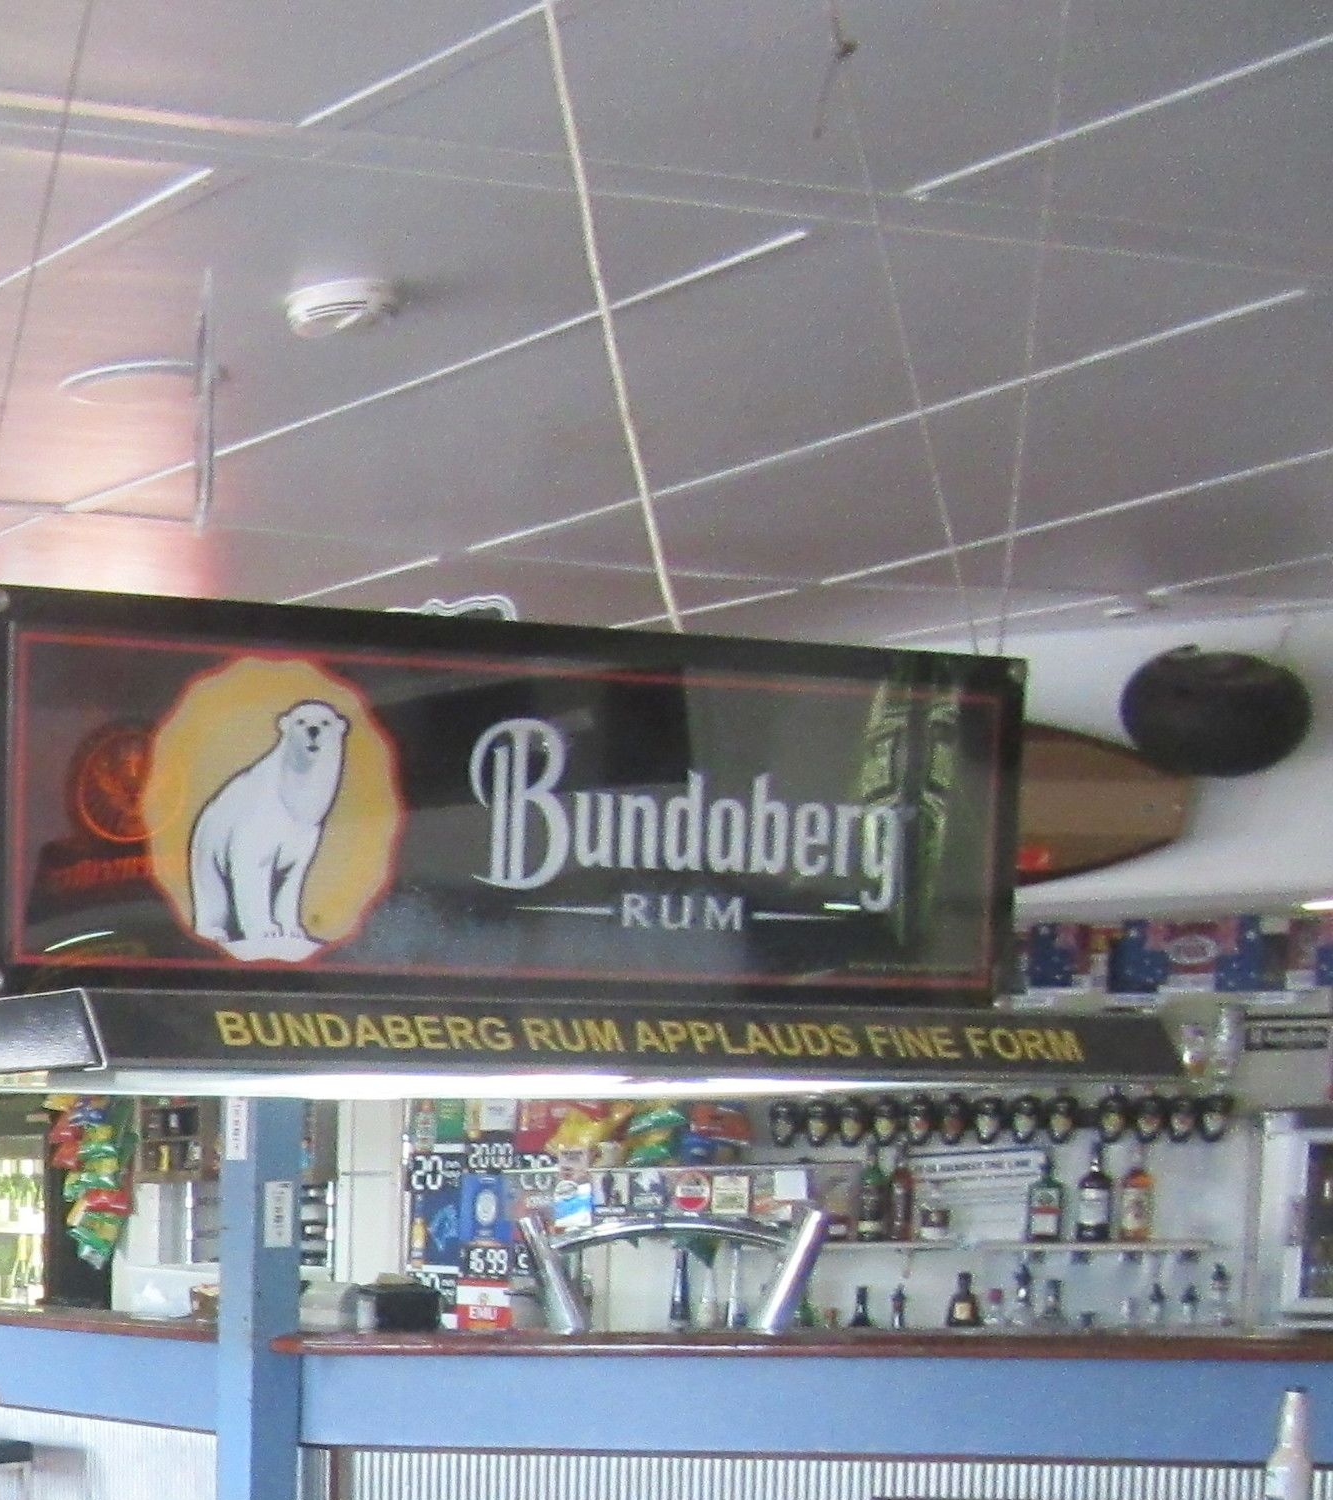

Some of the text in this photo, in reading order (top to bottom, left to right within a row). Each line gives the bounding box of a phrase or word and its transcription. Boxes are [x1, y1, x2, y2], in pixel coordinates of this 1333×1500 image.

[470, 718, 905, 914] Bundaberg
[621, 893, 744, 932] RUM
[215, 1010, 1086, 1063] BUNDABERG RUM APPLAUDS FINE FORM
[468, 1305, 499, 1322] EMU
